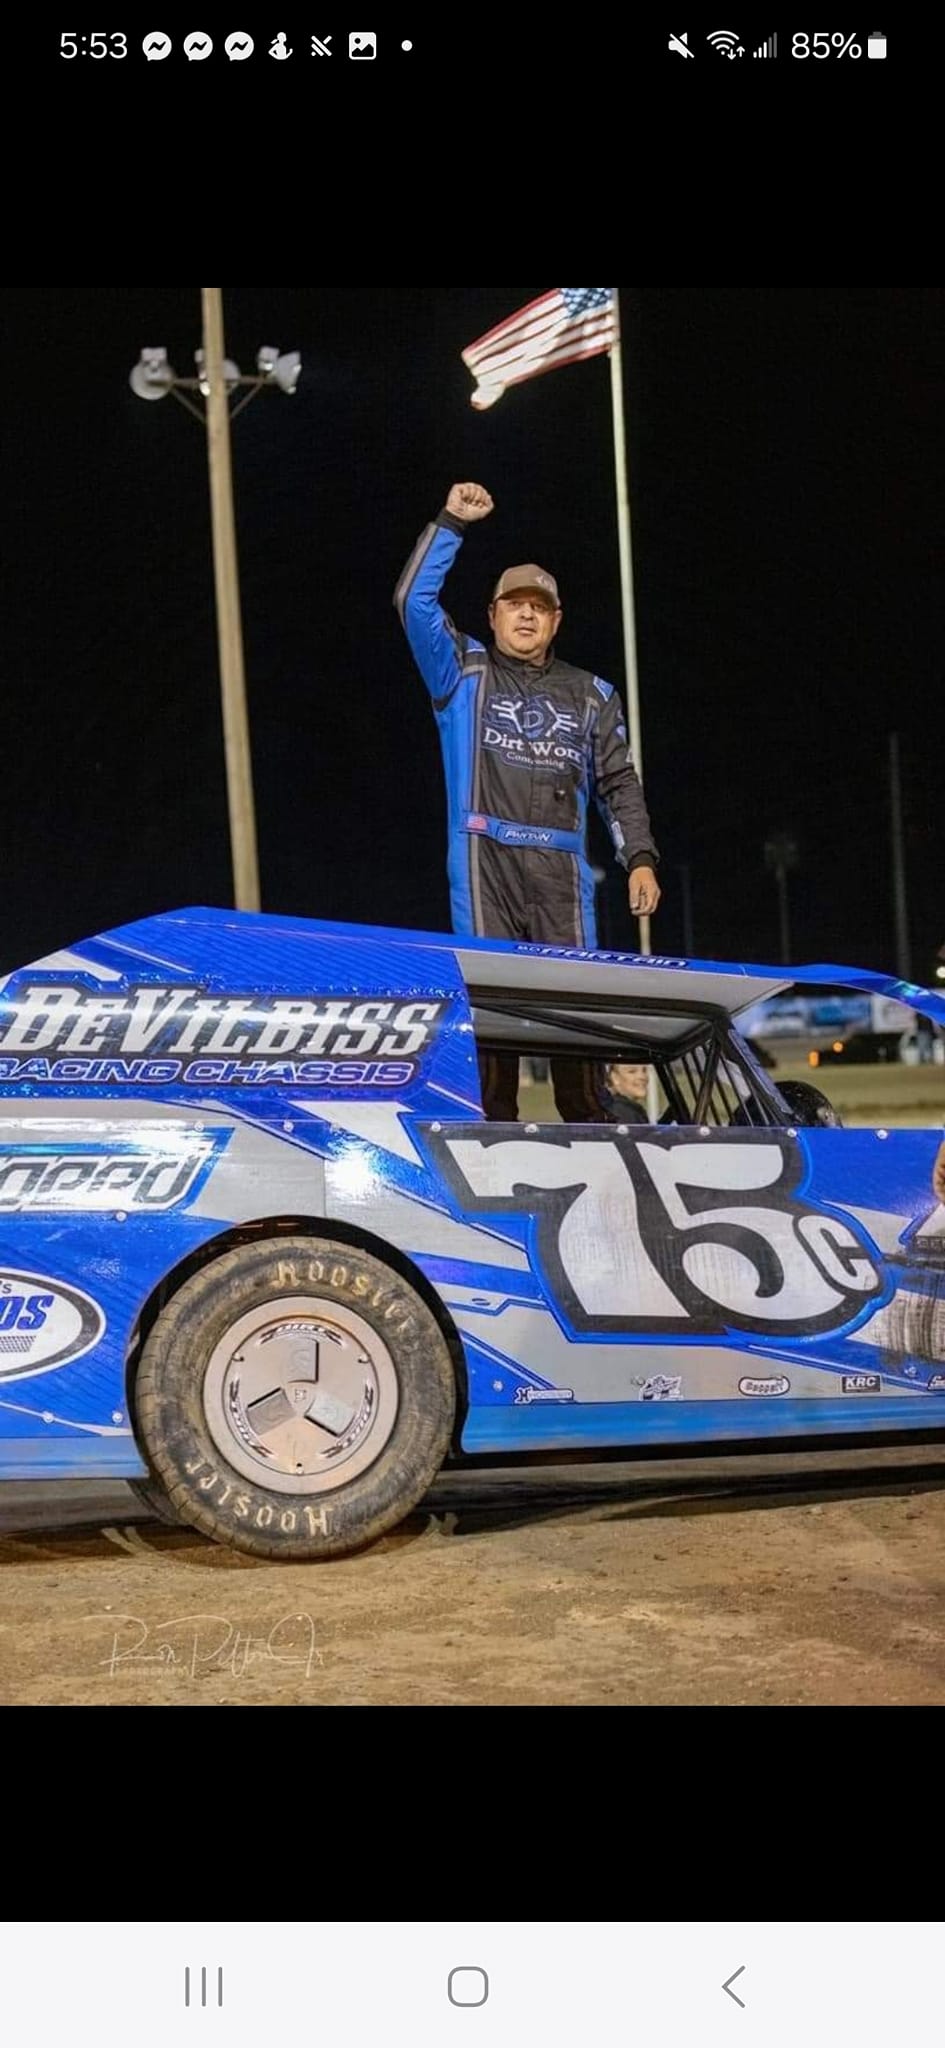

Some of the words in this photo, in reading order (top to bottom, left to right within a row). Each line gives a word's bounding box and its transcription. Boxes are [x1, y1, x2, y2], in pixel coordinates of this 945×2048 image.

[60, 32, 128, 59] 5:53
[791, 32, 862, 59] 85%
[483, 728, 524, 751] Dirt
[186, 1060, 415, 1085] CHASSIS
[845, 1376, 877, 1388] KRC
